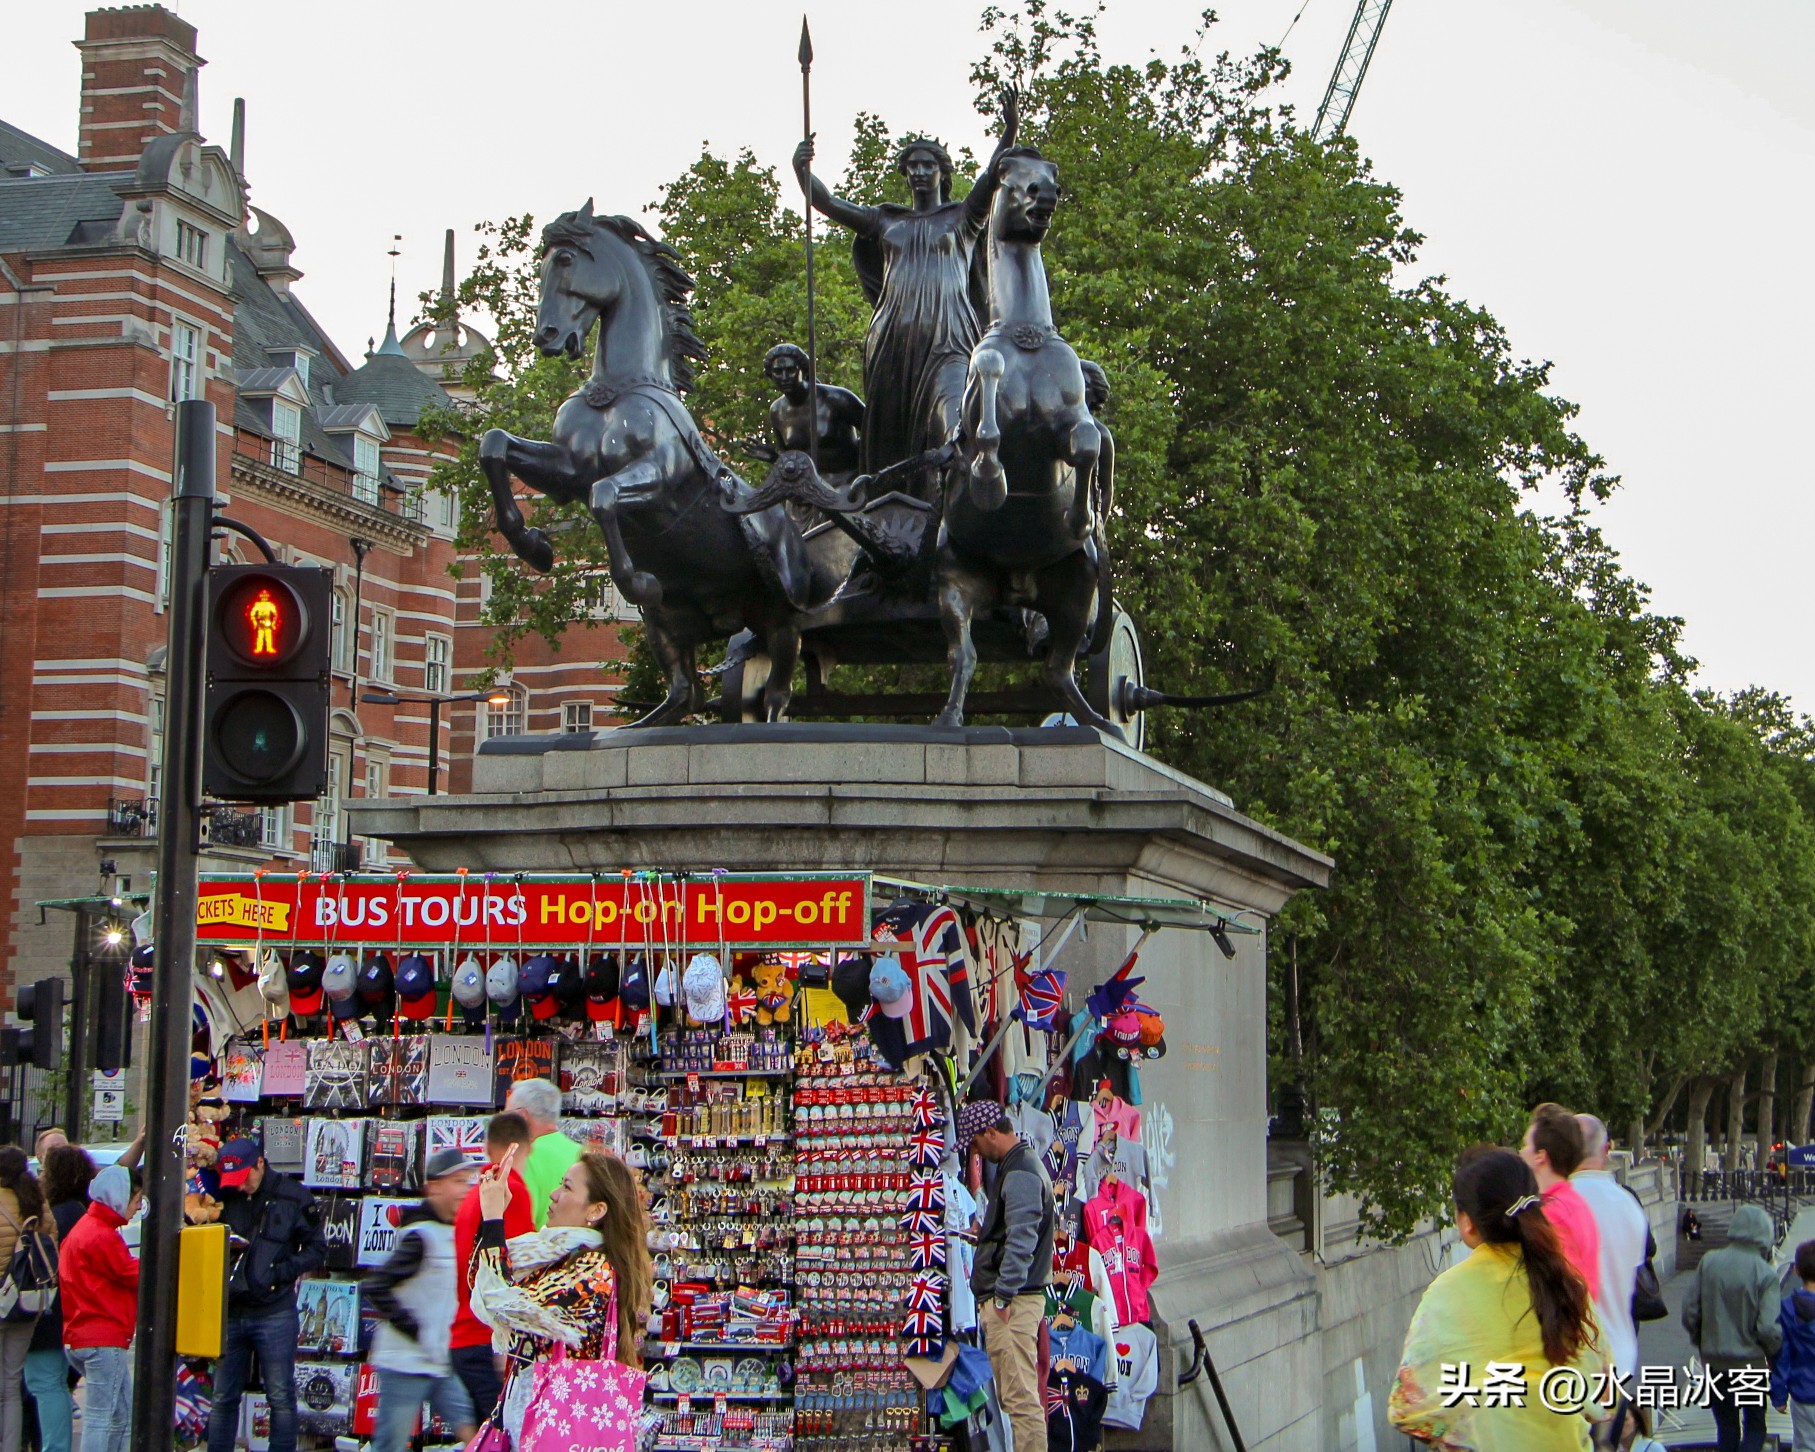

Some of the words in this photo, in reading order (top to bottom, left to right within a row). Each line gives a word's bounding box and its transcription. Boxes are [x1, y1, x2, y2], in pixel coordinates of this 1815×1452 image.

[241, 903, 274, 924] HERE
[316, 897, 388, 926] BUS
[399, 896, 527, 926] TOURS
[540, 894, 683, 931] Hop-on
[697, 892, 852, 931] Hop-off
[434, 1045, 490, 1069] LONDON
[497, 1040, 551, 1060] LONDON
[270, 1065, 304, 1079] LONDON
[372, 1063, 420, 1075] LONDON
[570, 1073, 604, 1090] London
[270, 1125, 299, 1136] LONDON
[430, 1119, 474, 1127] LONDON
[372, 1204, 383, 1227] I
